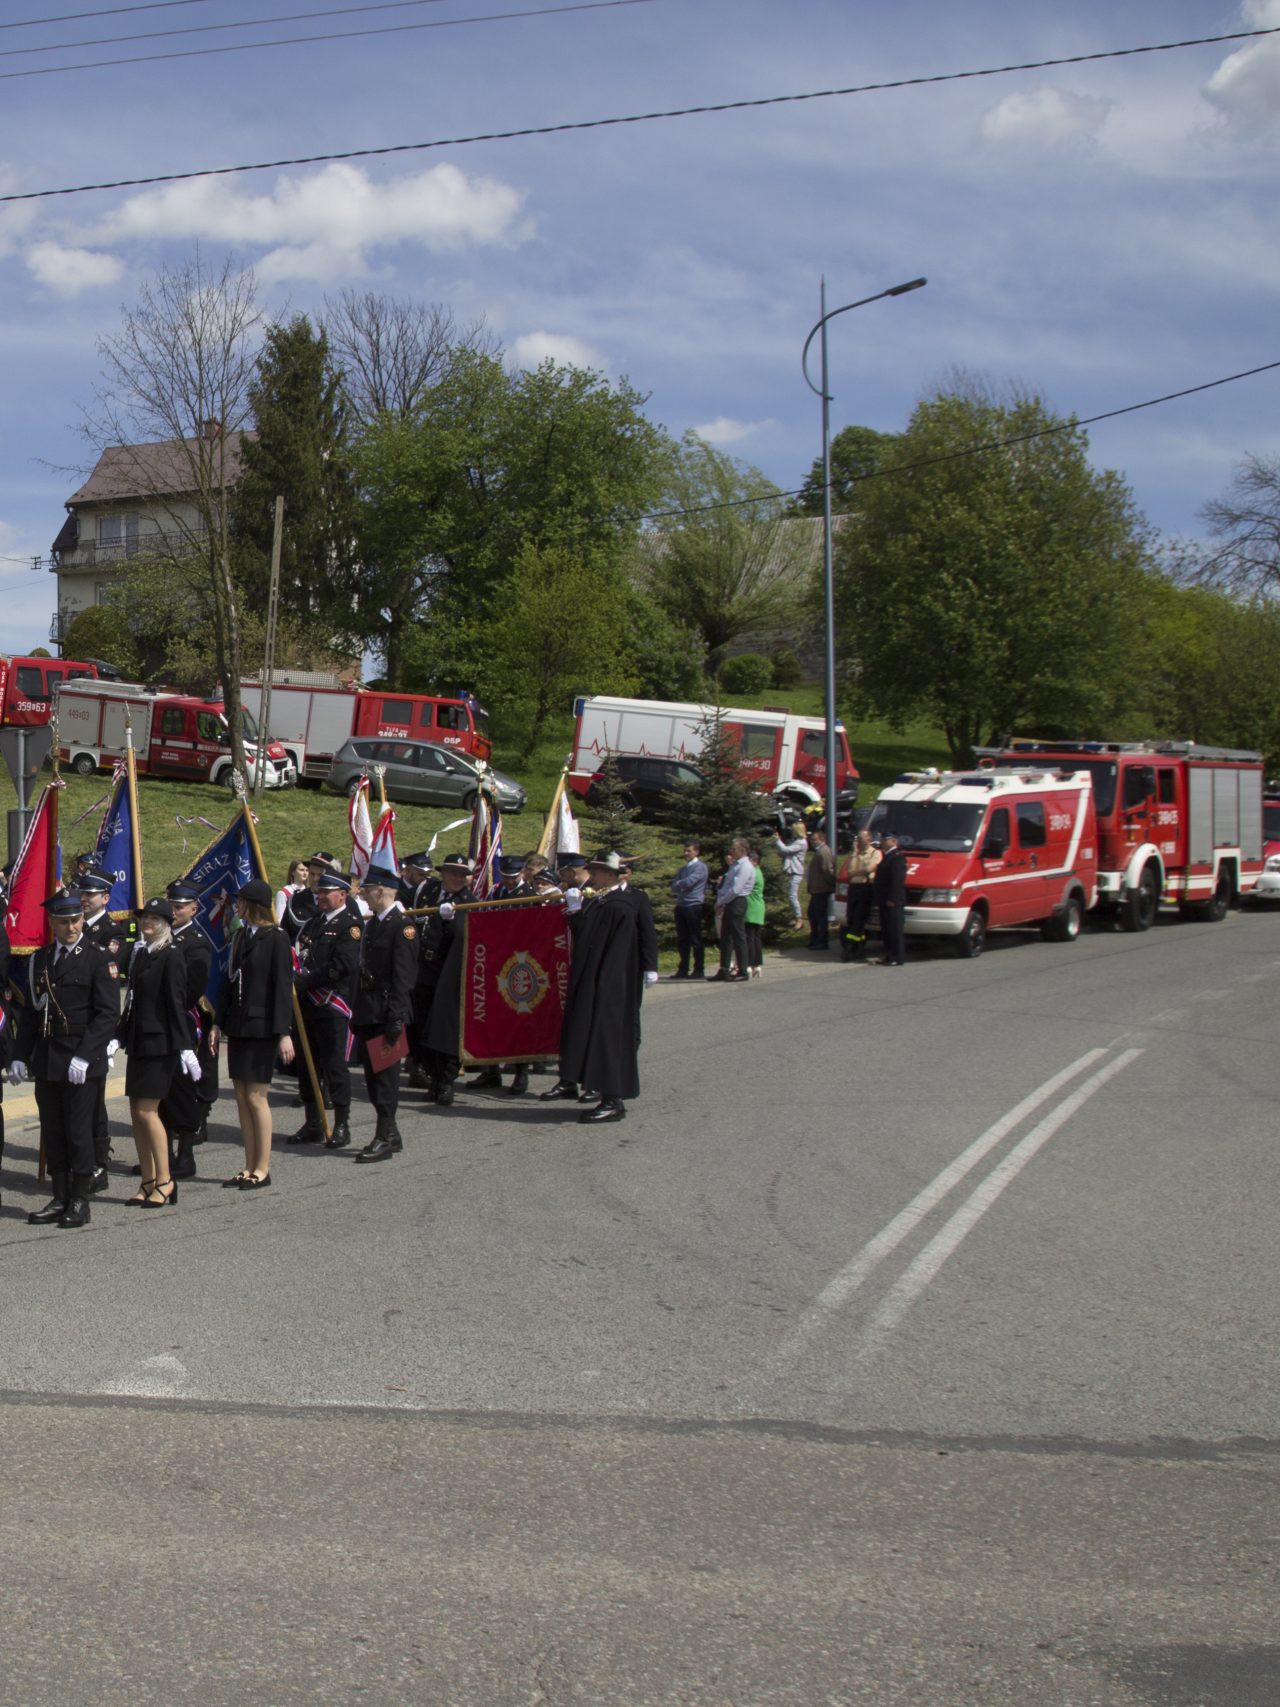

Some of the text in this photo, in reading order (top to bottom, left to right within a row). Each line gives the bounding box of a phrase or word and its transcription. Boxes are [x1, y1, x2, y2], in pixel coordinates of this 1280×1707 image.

[443, 736, 462, 745] OSP
[192, 853, 231, 884] STRAŻ
[554, 933, 566, 949] W
[472, 943, 486, 1023] OJCZYZNY
